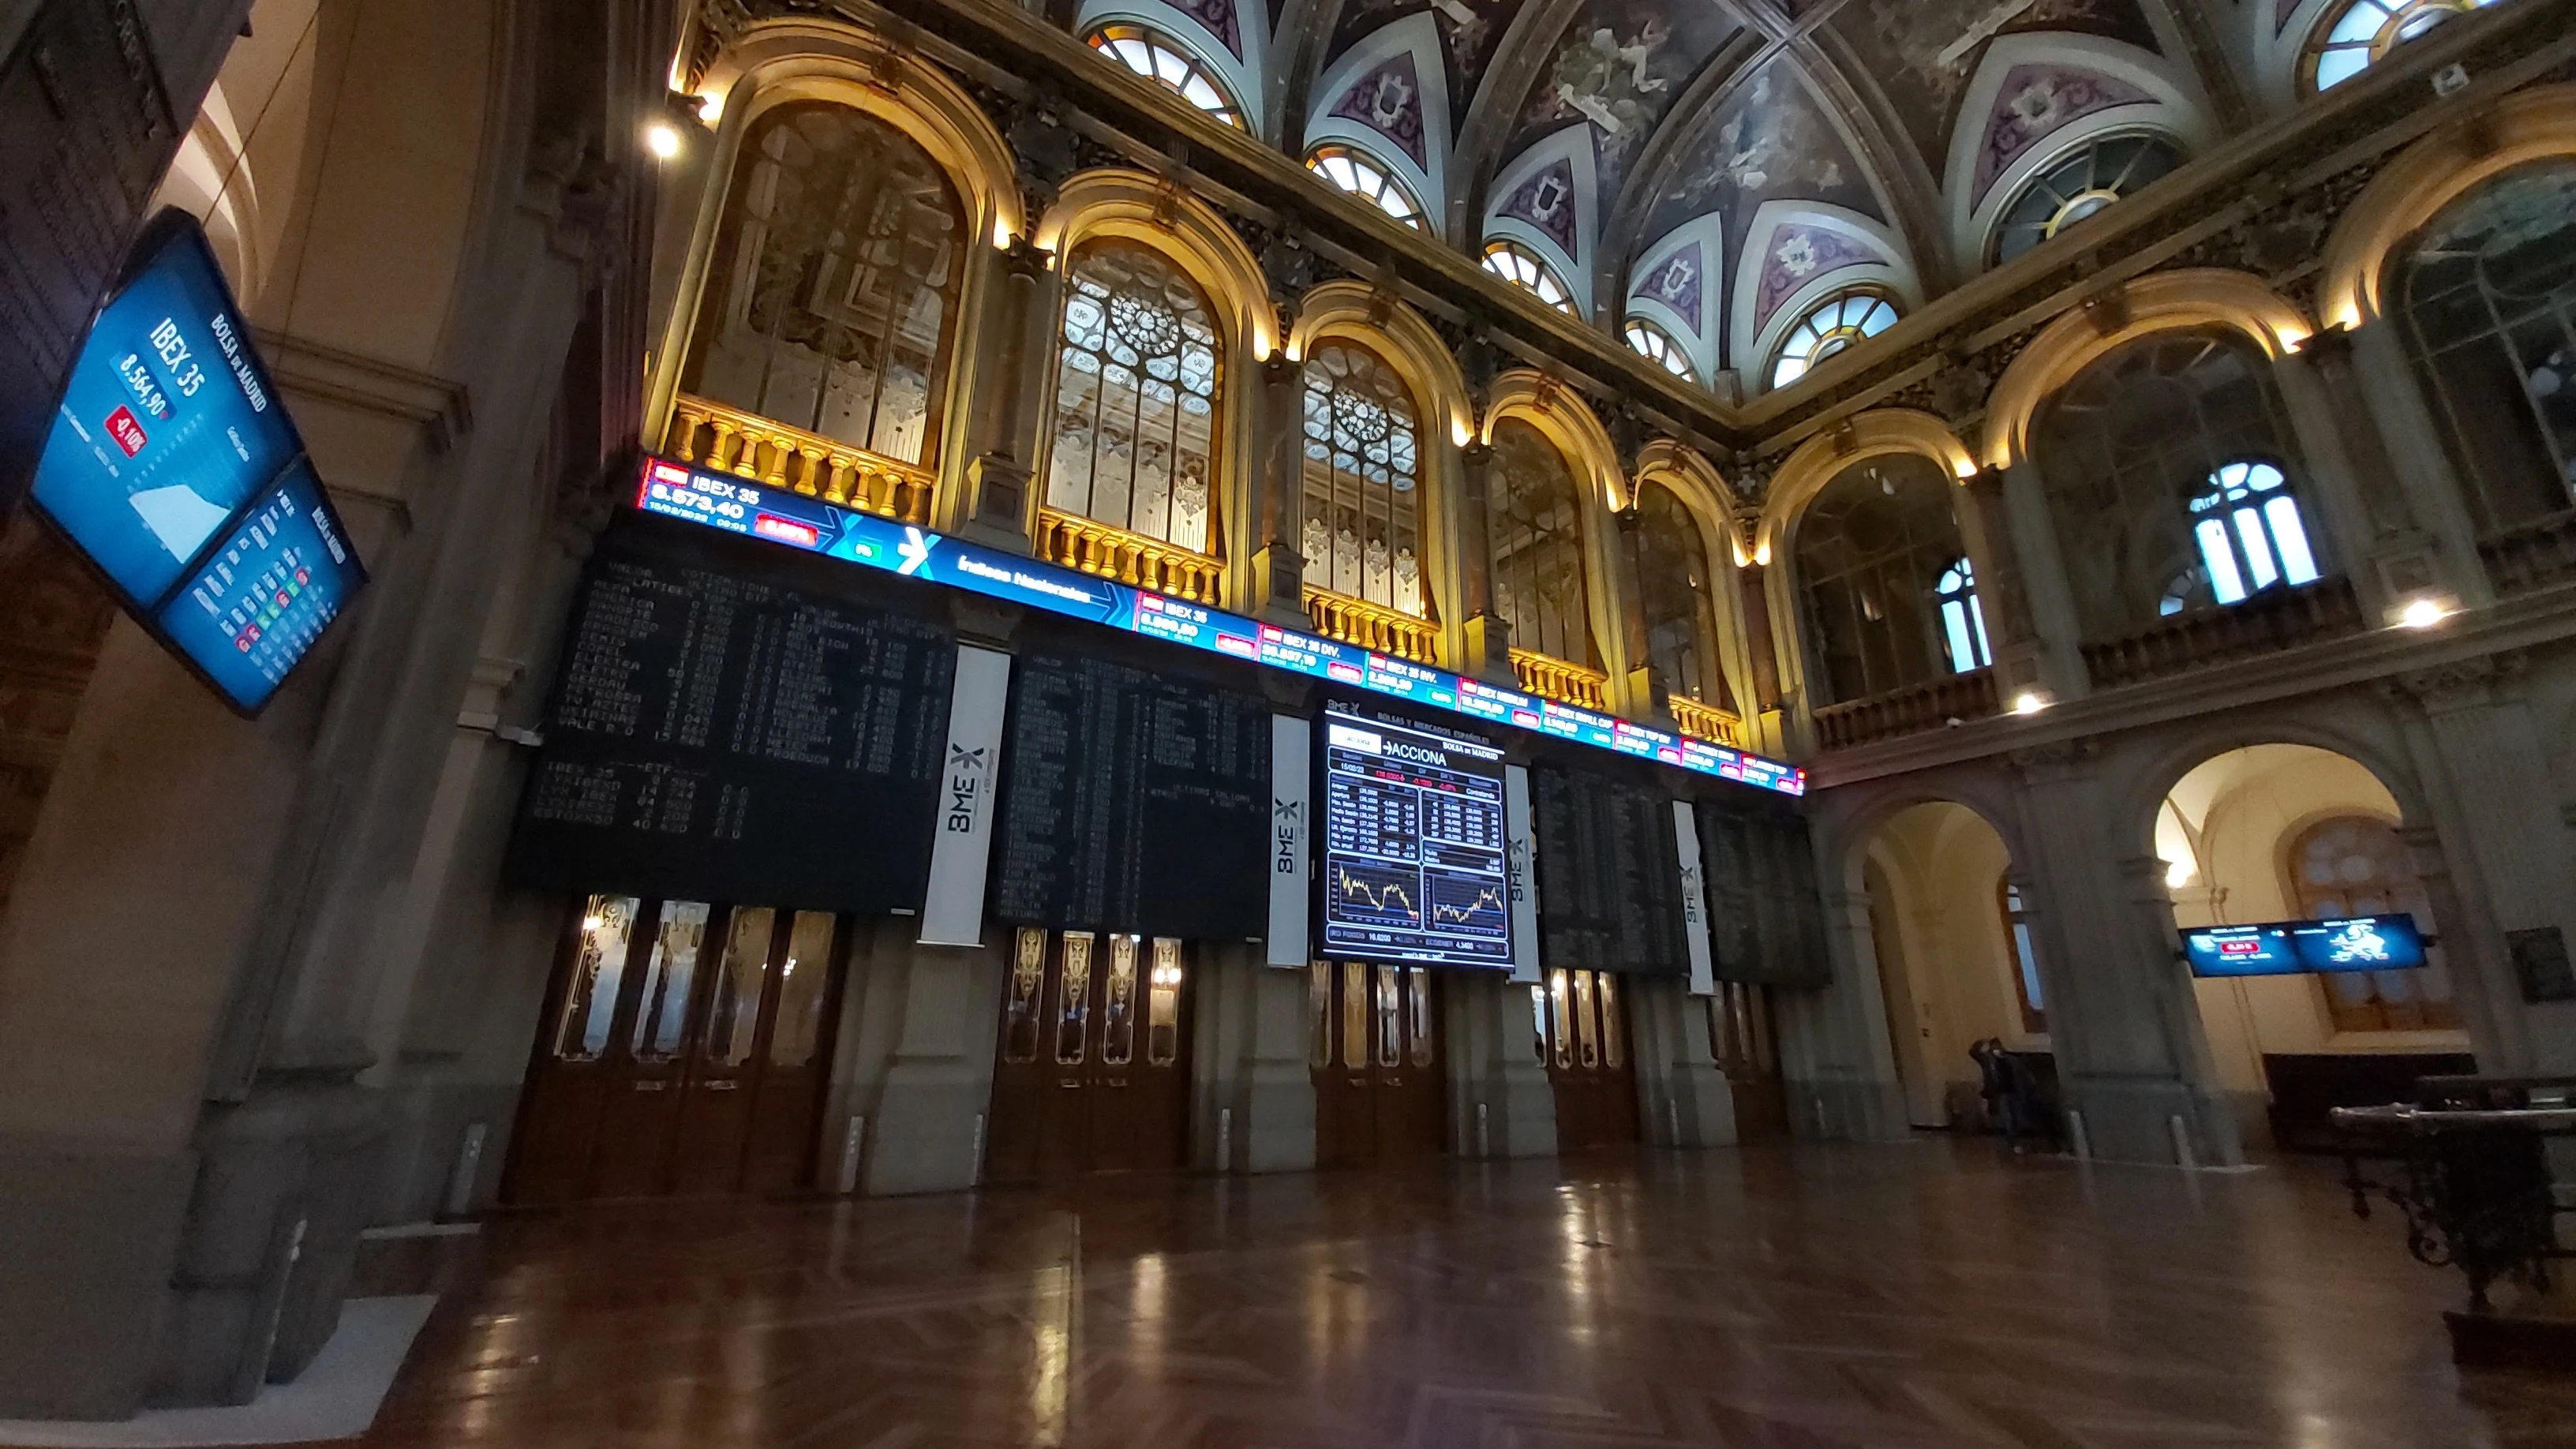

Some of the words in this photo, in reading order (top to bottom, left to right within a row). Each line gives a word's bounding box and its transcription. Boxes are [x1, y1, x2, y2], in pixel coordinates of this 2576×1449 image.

[151, 318, 190, 372] IBEX
[177, 364, 204, 395] 35
[212, 313, 237, 358] BOLSA
[238, 365, 266, 411] MADRID
[692, 476, 735, 498] IBEX
[738, 488, 758, 504] 35
[652, 484, 743, 518] 8.573,40
[1165, 602, 1191, 619] IBEX
[1193, 610, 1207, 623] 35
[1282, 634, 1306, 648] IBEX
[1386, 661, 1407, 675] IBEX
[558, 717, 595, 730] VALE
[1391, 743, 1446, 765] ACCIONA
[1443, 741, 1463, 752] BOLSA
[1472, 748, 1498, 759] MADRID
